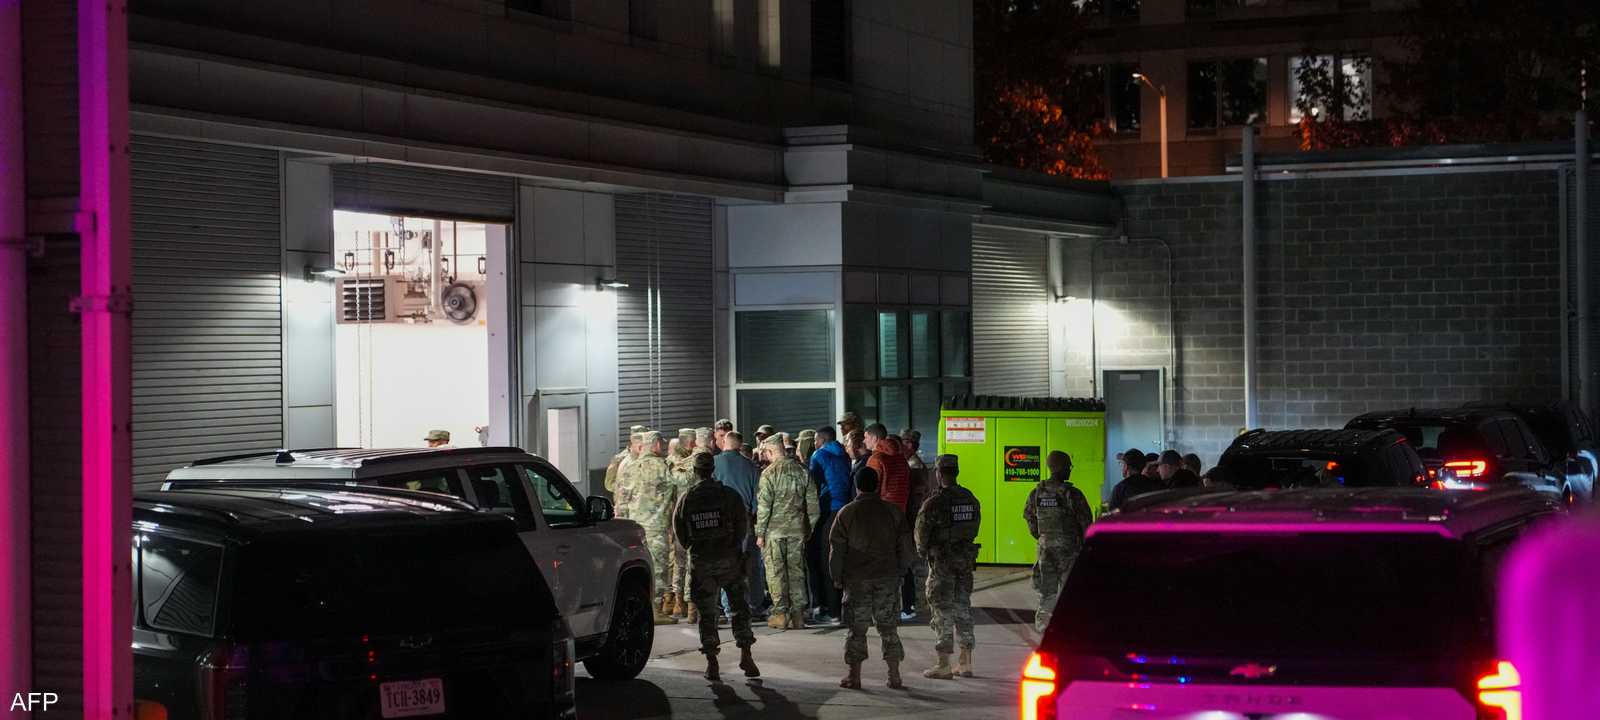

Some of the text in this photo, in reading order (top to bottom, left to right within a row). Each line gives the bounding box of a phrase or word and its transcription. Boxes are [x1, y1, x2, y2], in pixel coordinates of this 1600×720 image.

[951, 505, 976, 513] NATIONAL
[690, 511, 720, 521] NATIONAL
[953, 513, 973, 521] GUARD
[695, 520, 719, 529] GUARD
